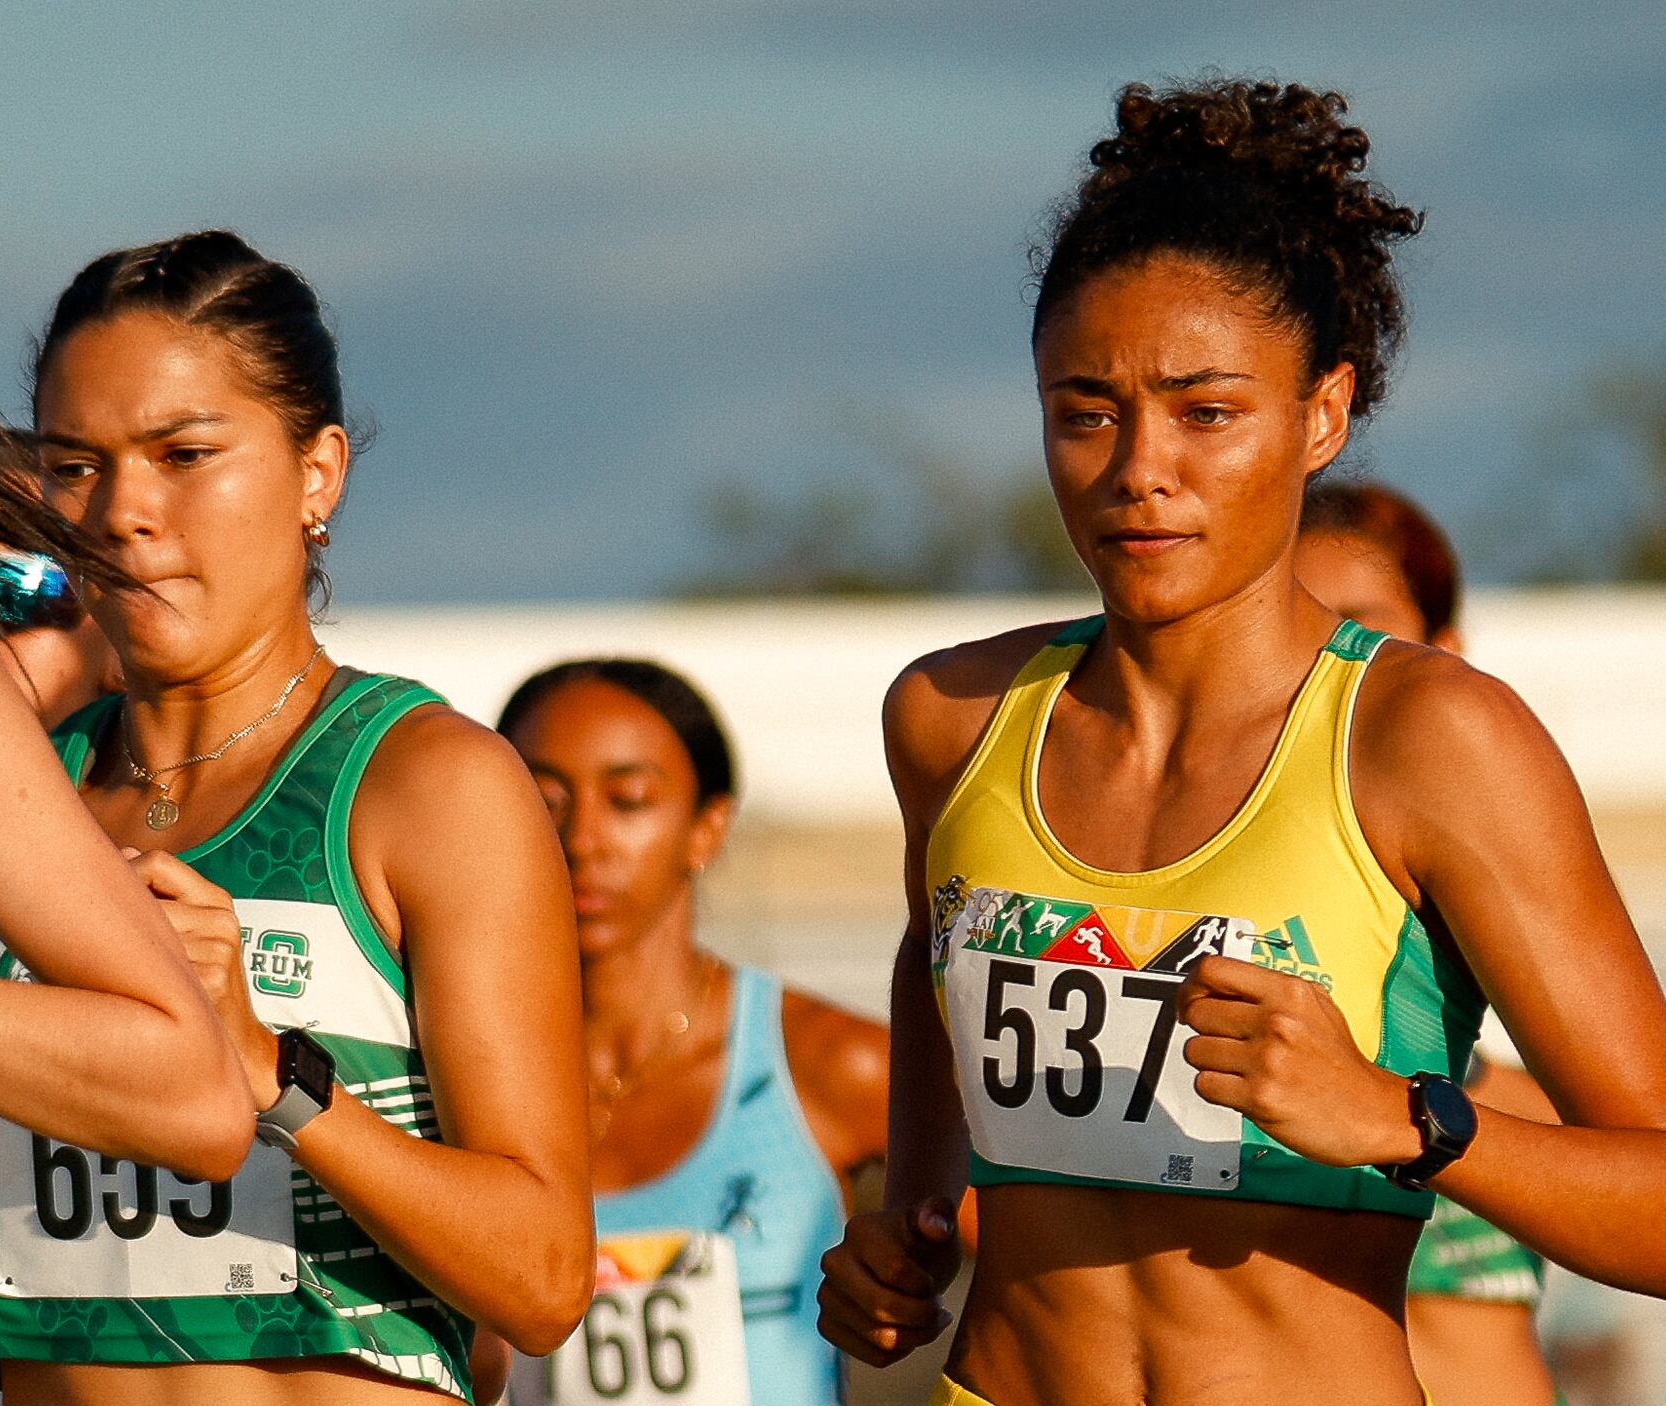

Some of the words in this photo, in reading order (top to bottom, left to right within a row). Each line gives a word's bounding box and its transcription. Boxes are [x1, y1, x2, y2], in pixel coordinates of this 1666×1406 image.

[250, 952, 314, 981] RUM
[982, 960, 1183, 1124] 537
[544, 1289, 693, 1400] 66
